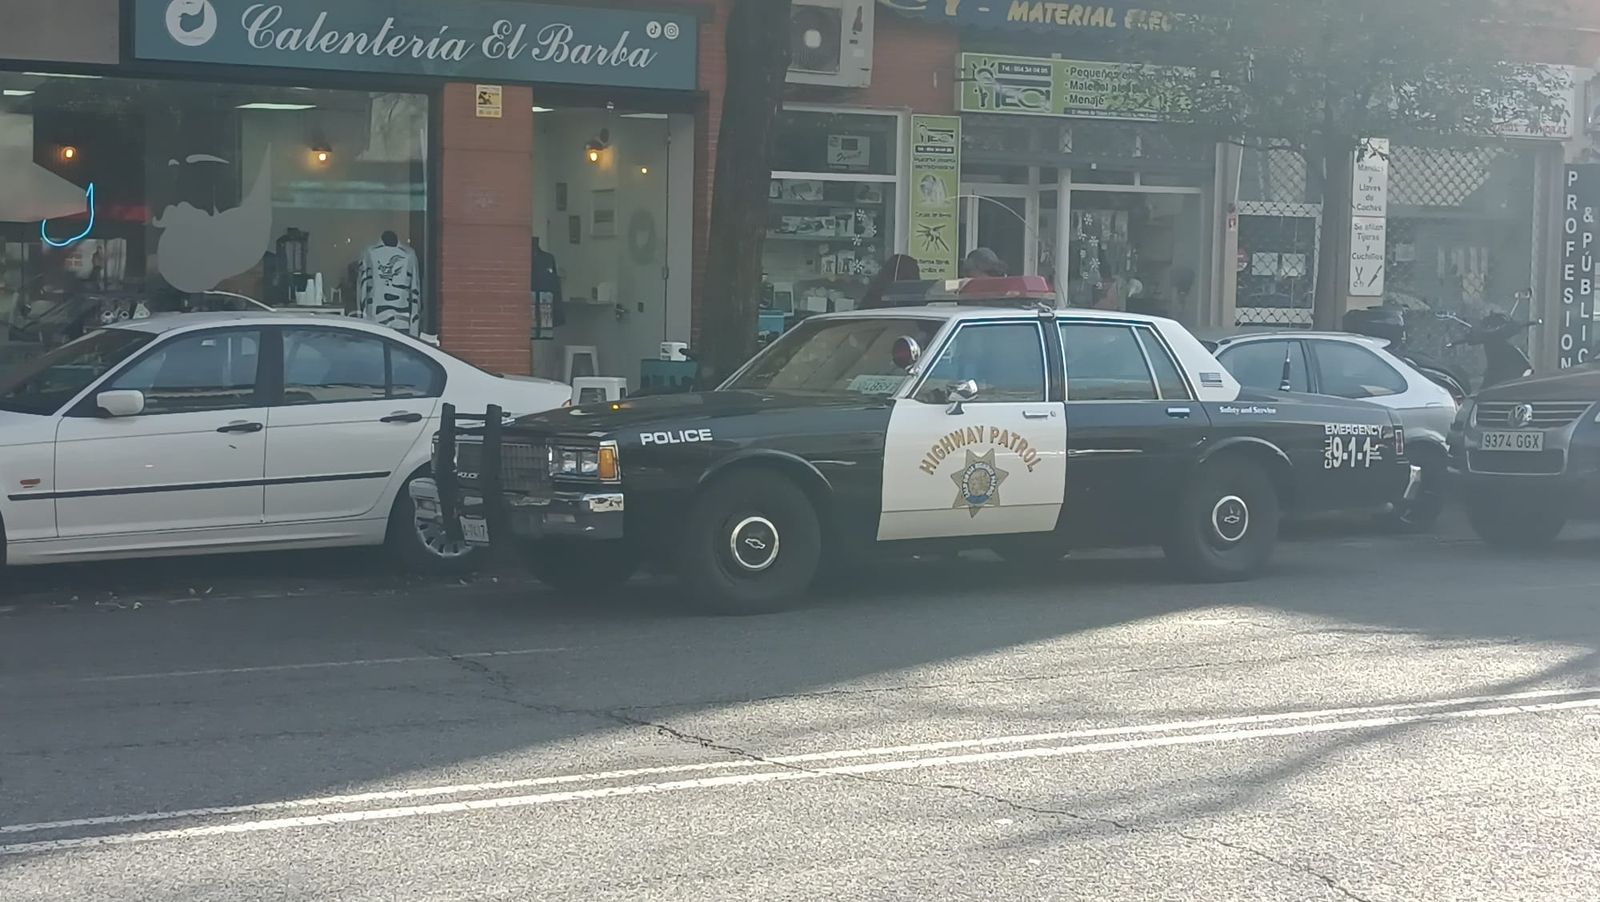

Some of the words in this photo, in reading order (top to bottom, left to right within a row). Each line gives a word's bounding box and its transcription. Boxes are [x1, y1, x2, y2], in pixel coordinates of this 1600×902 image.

[1007, 0, 1117, 28] MATERIAL
[242, 3, 477, 63] Calentería
[482, 19, 528, 61] El
[531, 23, 658, 69] Barba
[1069, 80, 1109, 92] Mateal
[1069, 94, 1105, 106] Menaje
[1240, 406, 1252, 414] and
[640, 428, 713, 445] POLICE
[1324, 424, 1383, 439] EMERGENCY
[1484, 433, 1511, 448] 9374
[1516, 434, 1540, 449] GGX
[919, 425, 984, 475] HIGHWAY
[989, 425, 1042, 473] PATROL
[1324, 435, 1333, 469] CALL
